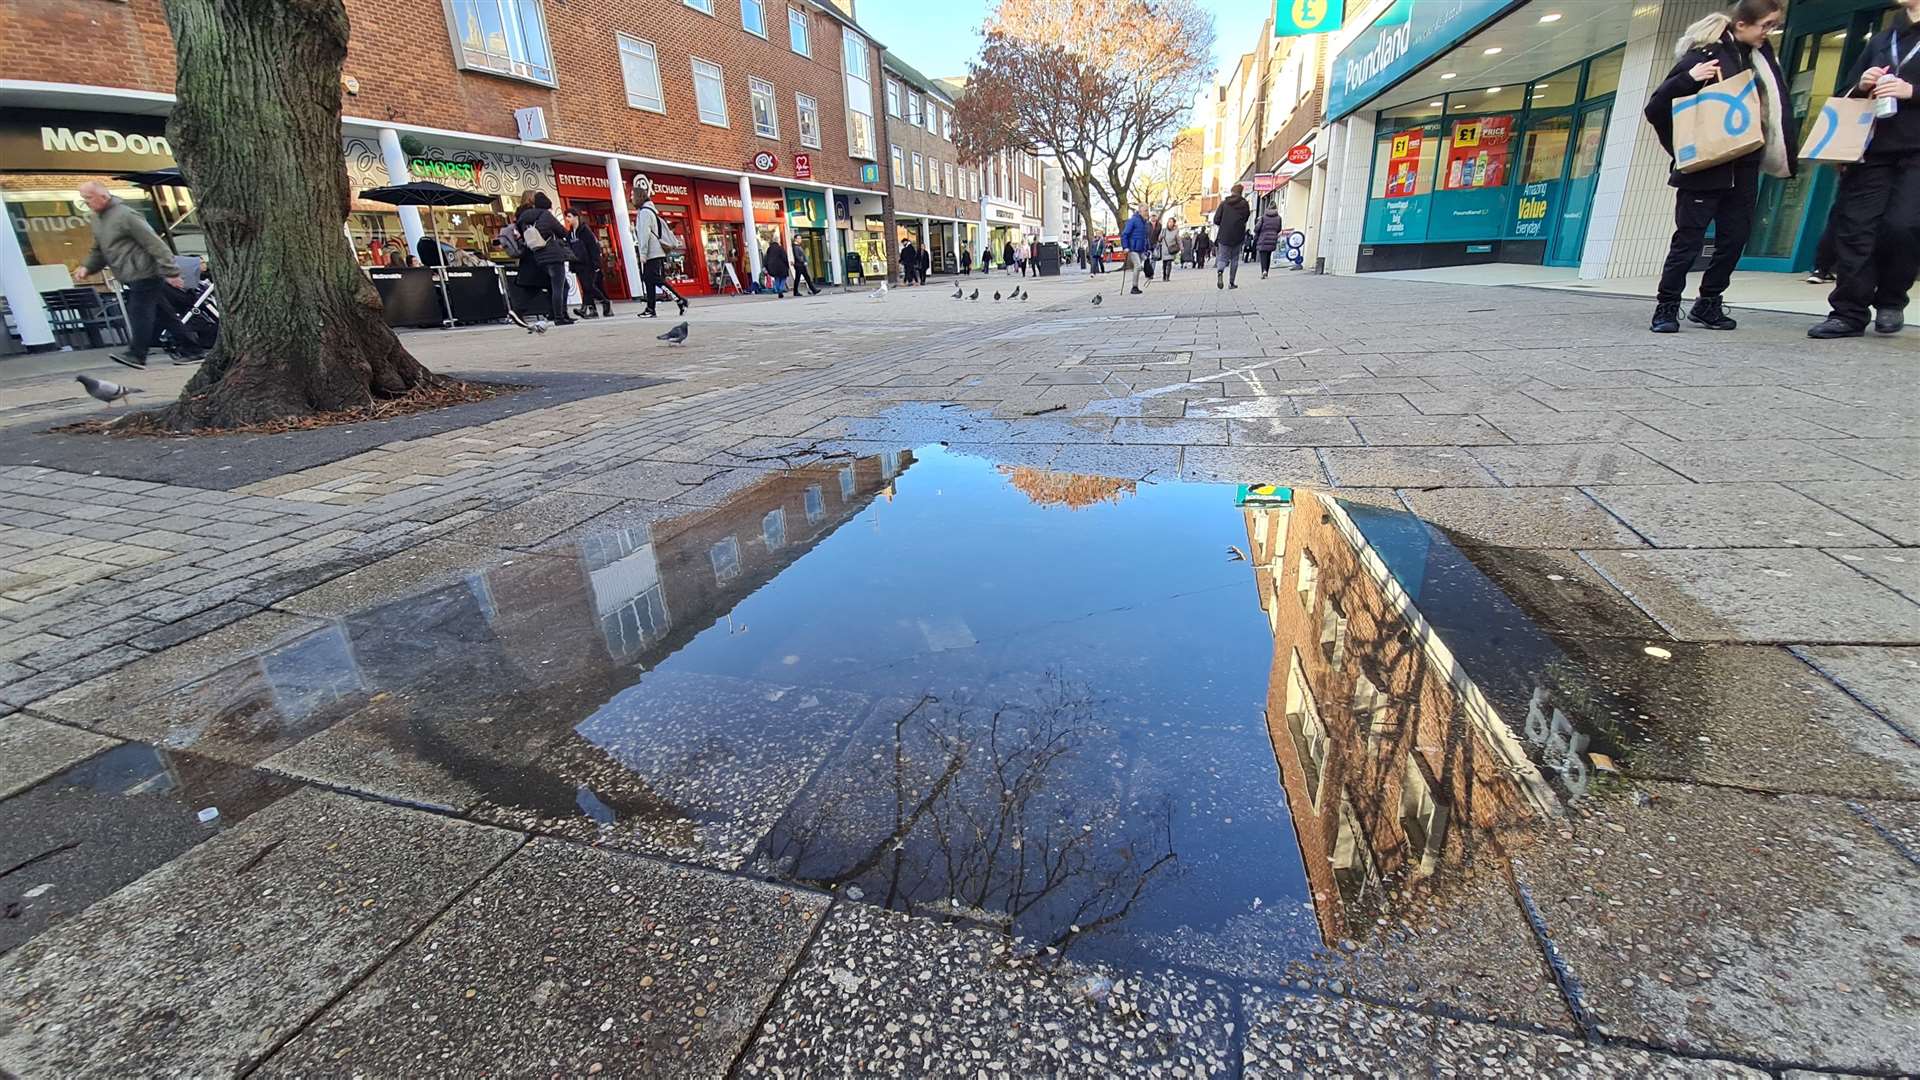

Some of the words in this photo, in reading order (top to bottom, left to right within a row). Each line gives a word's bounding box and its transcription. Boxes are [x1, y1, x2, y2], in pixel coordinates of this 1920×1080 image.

[1344, 3, 1412, 96] Poundland
[41, 127, 173, 155] McDon
[1460, 128, 1476, 140] £1
[1482, 127, 1505, 137] PRICE
[1395, 141, 1405, 152] £1
[559, 174, 627, 190] ENTERTAINT
[654, 183, 688, 195] EXCHANGE
[1524, 182, 1547, 196] Amazing
[704, 194, 727, 207] British
[752, 200, 780, 210] oundation
[1518, 197, 1547, 219] Value
